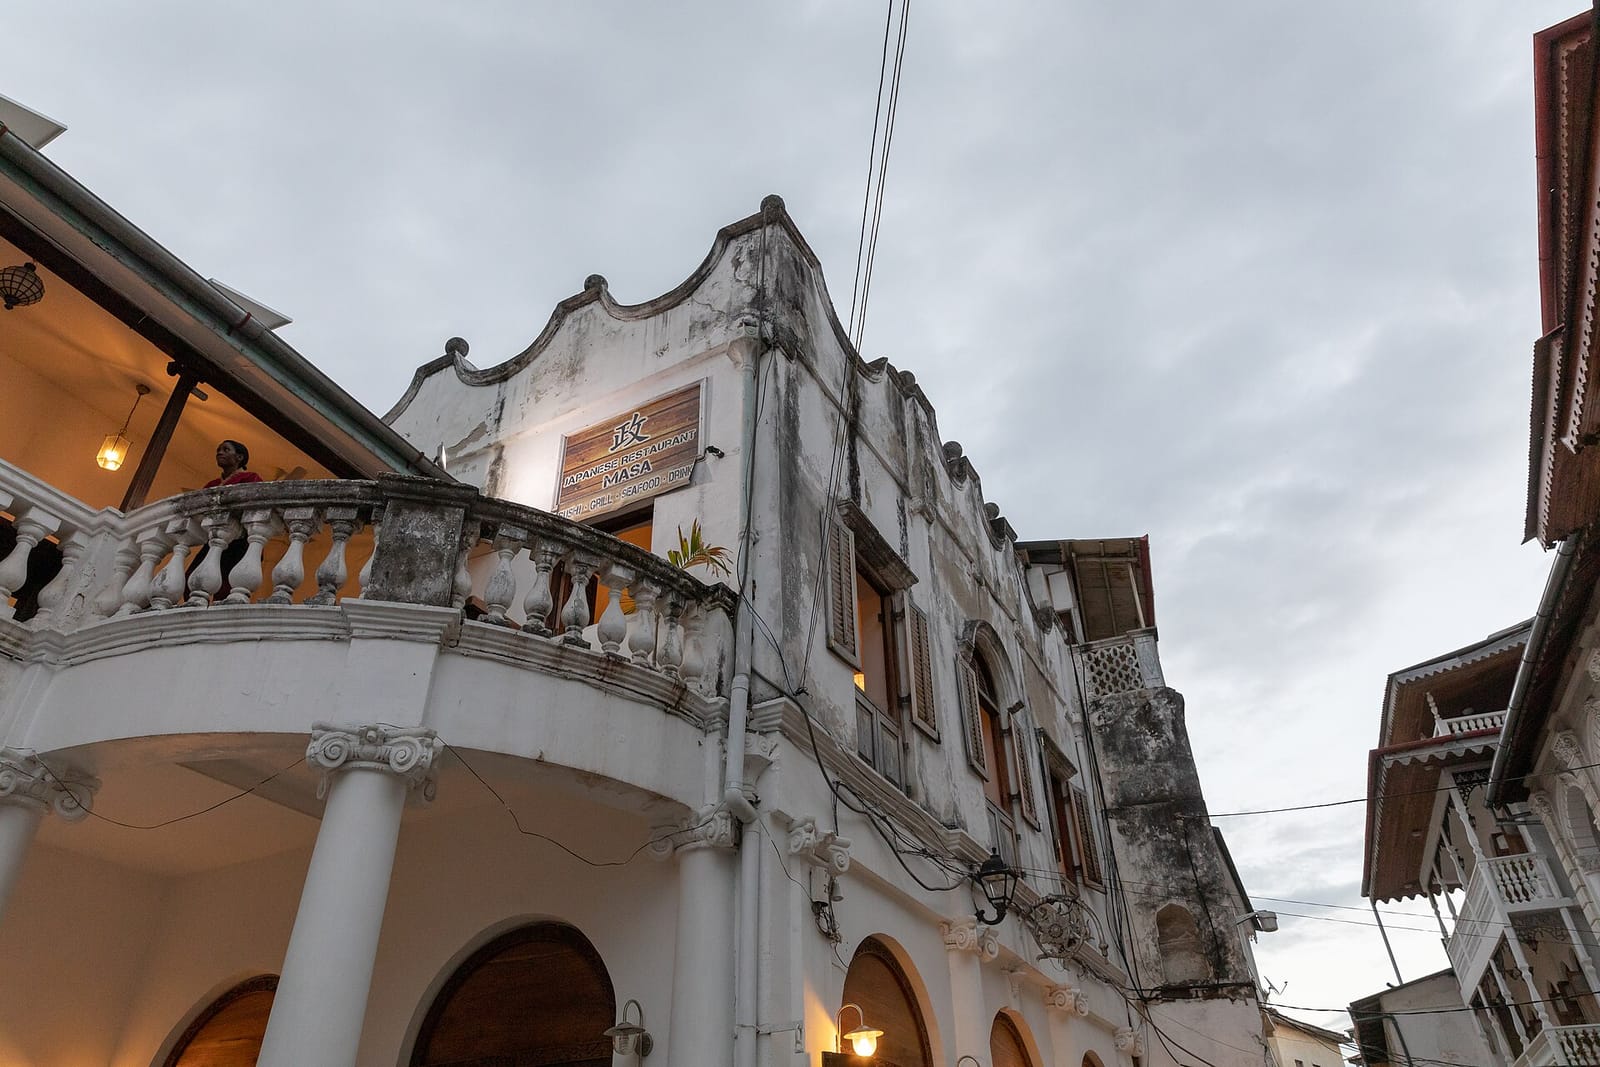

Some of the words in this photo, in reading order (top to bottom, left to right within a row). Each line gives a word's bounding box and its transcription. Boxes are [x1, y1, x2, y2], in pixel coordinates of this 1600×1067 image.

[609, 412, 650, 452] 政
[564, 459, 618, 487] JAPANESE
[621, 430, 697, 466] RESTAURANT
[603, 460, 652, 488] MASA
[590, 496, 613, 510] GRILL
[621, 477, 661, 499] SEAFOOD
